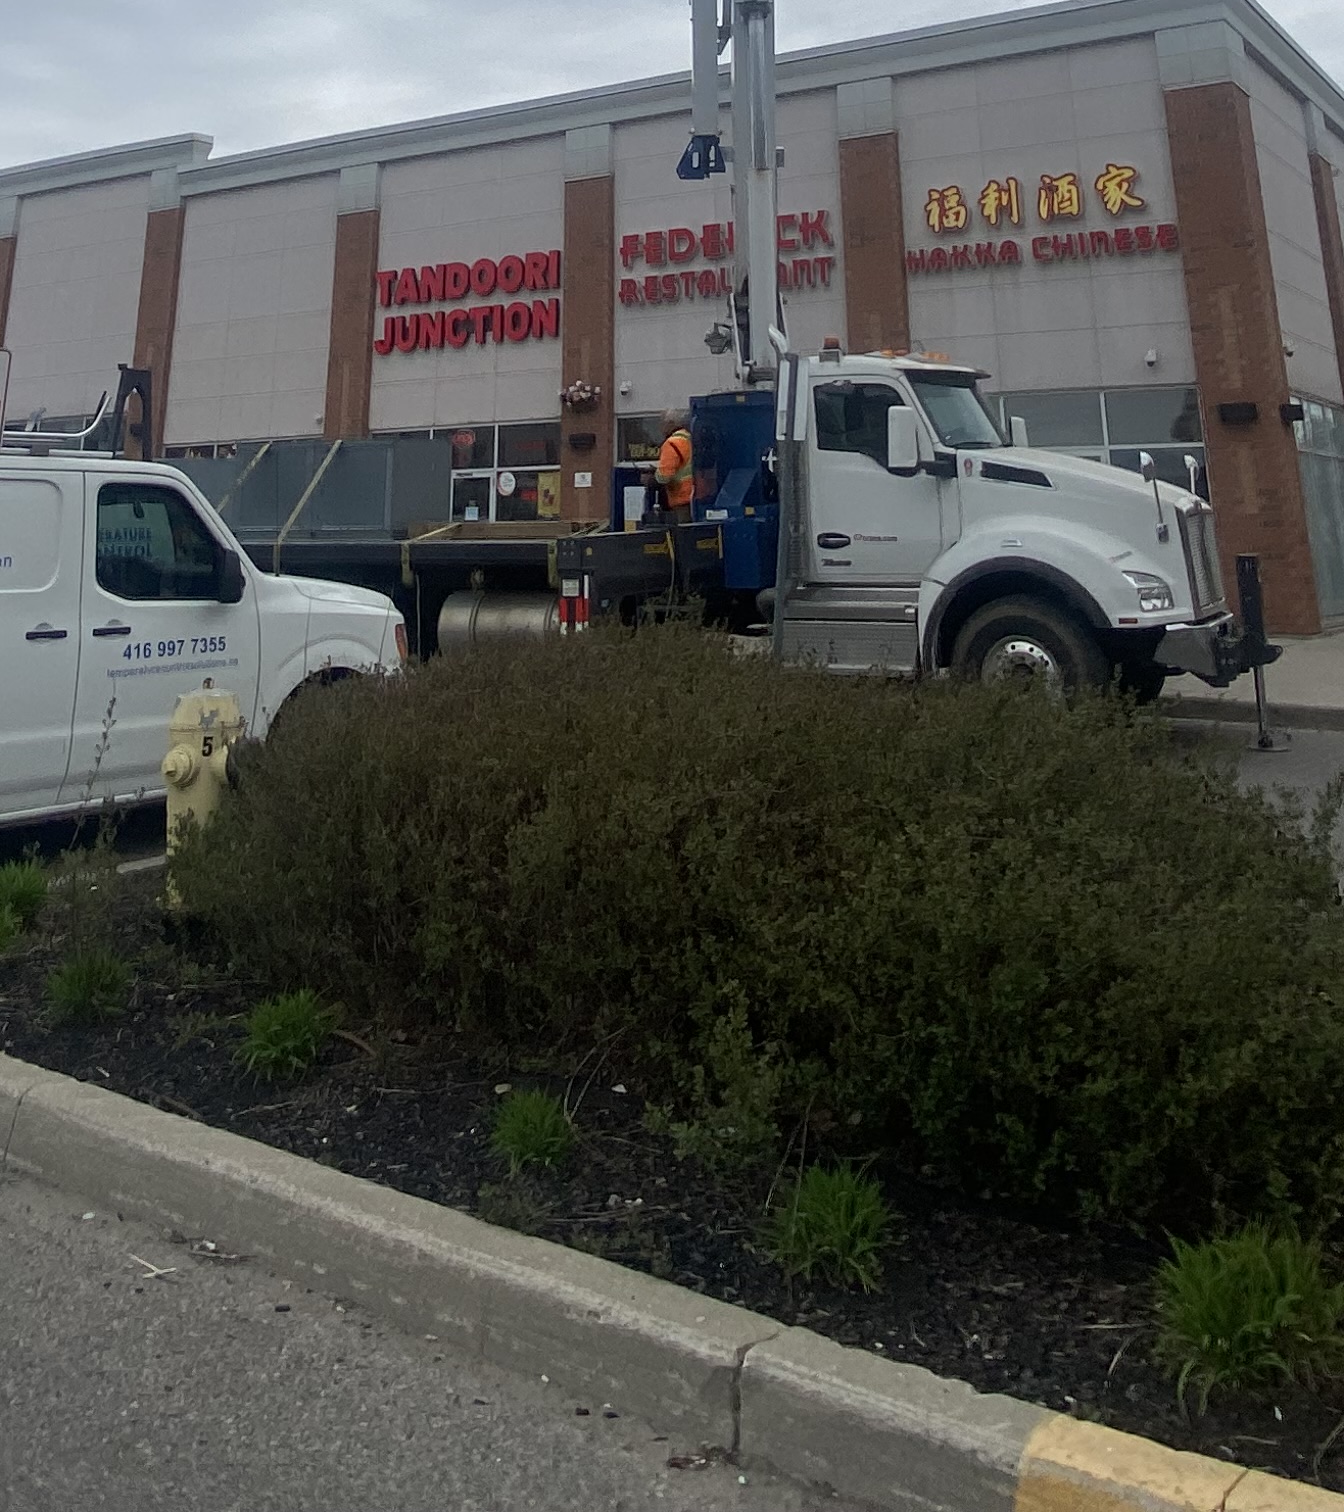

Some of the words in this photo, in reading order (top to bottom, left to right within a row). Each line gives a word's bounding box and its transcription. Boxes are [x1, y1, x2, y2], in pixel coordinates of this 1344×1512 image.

[924, 164, 1145, 233] 福利酒家
[620, 210, 834, 267] FEDECK
[906, 240, 1022, 272] HAKKA
[1031, 223, 1179, 263] CHINESE
[375, 250, 561, 307] TANDOORI
[619, 255, 835, 306] RESTAUANT
[375, 298, 560, 355] JUNCTION
[123, 642, 152, 660] 416
[157, 639, 186, 657] 997
[191, 636, 227, 654] 7355
